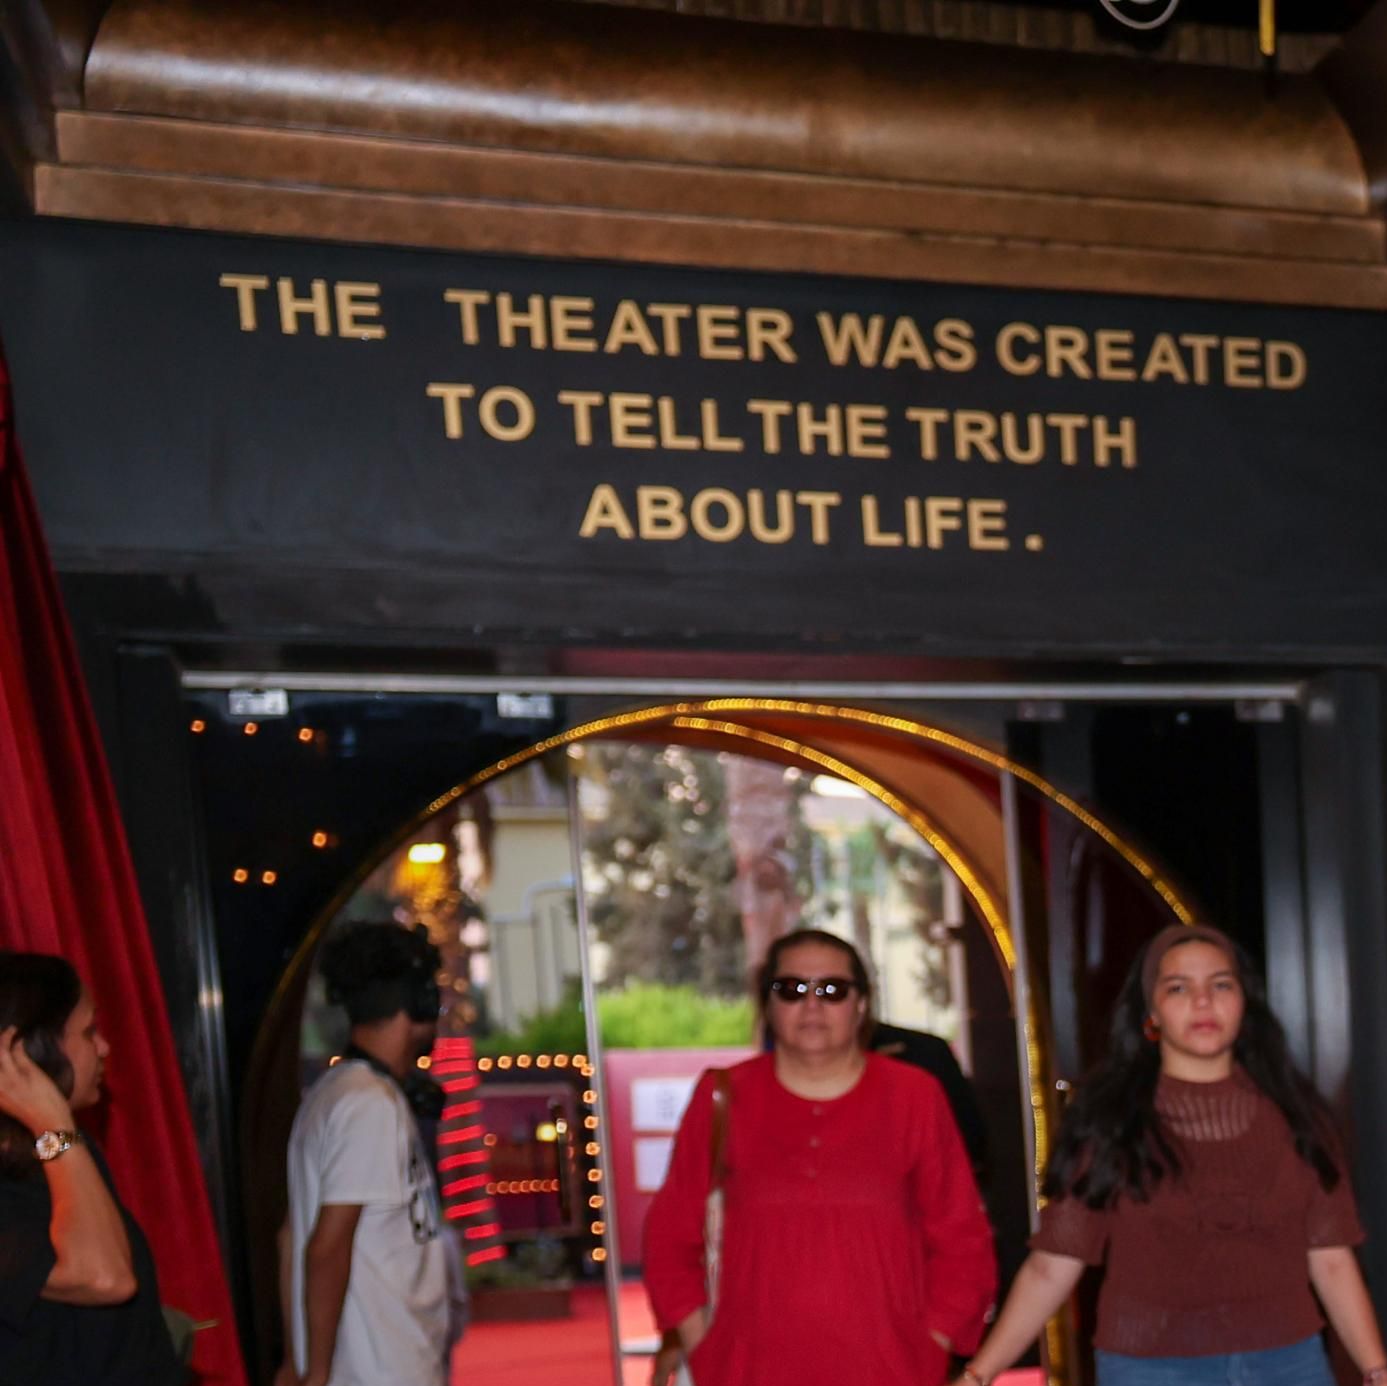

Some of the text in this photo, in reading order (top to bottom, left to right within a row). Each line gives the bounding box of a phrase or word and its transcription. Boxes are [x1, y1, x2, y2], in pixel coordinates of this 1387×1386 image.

[221, 274, 1307, 389] THE THEATER WAS CREATED
[425, 382, 1137, 467] TO TELL THE TRUTH
[579, 482, 843, 546] ABOUT
